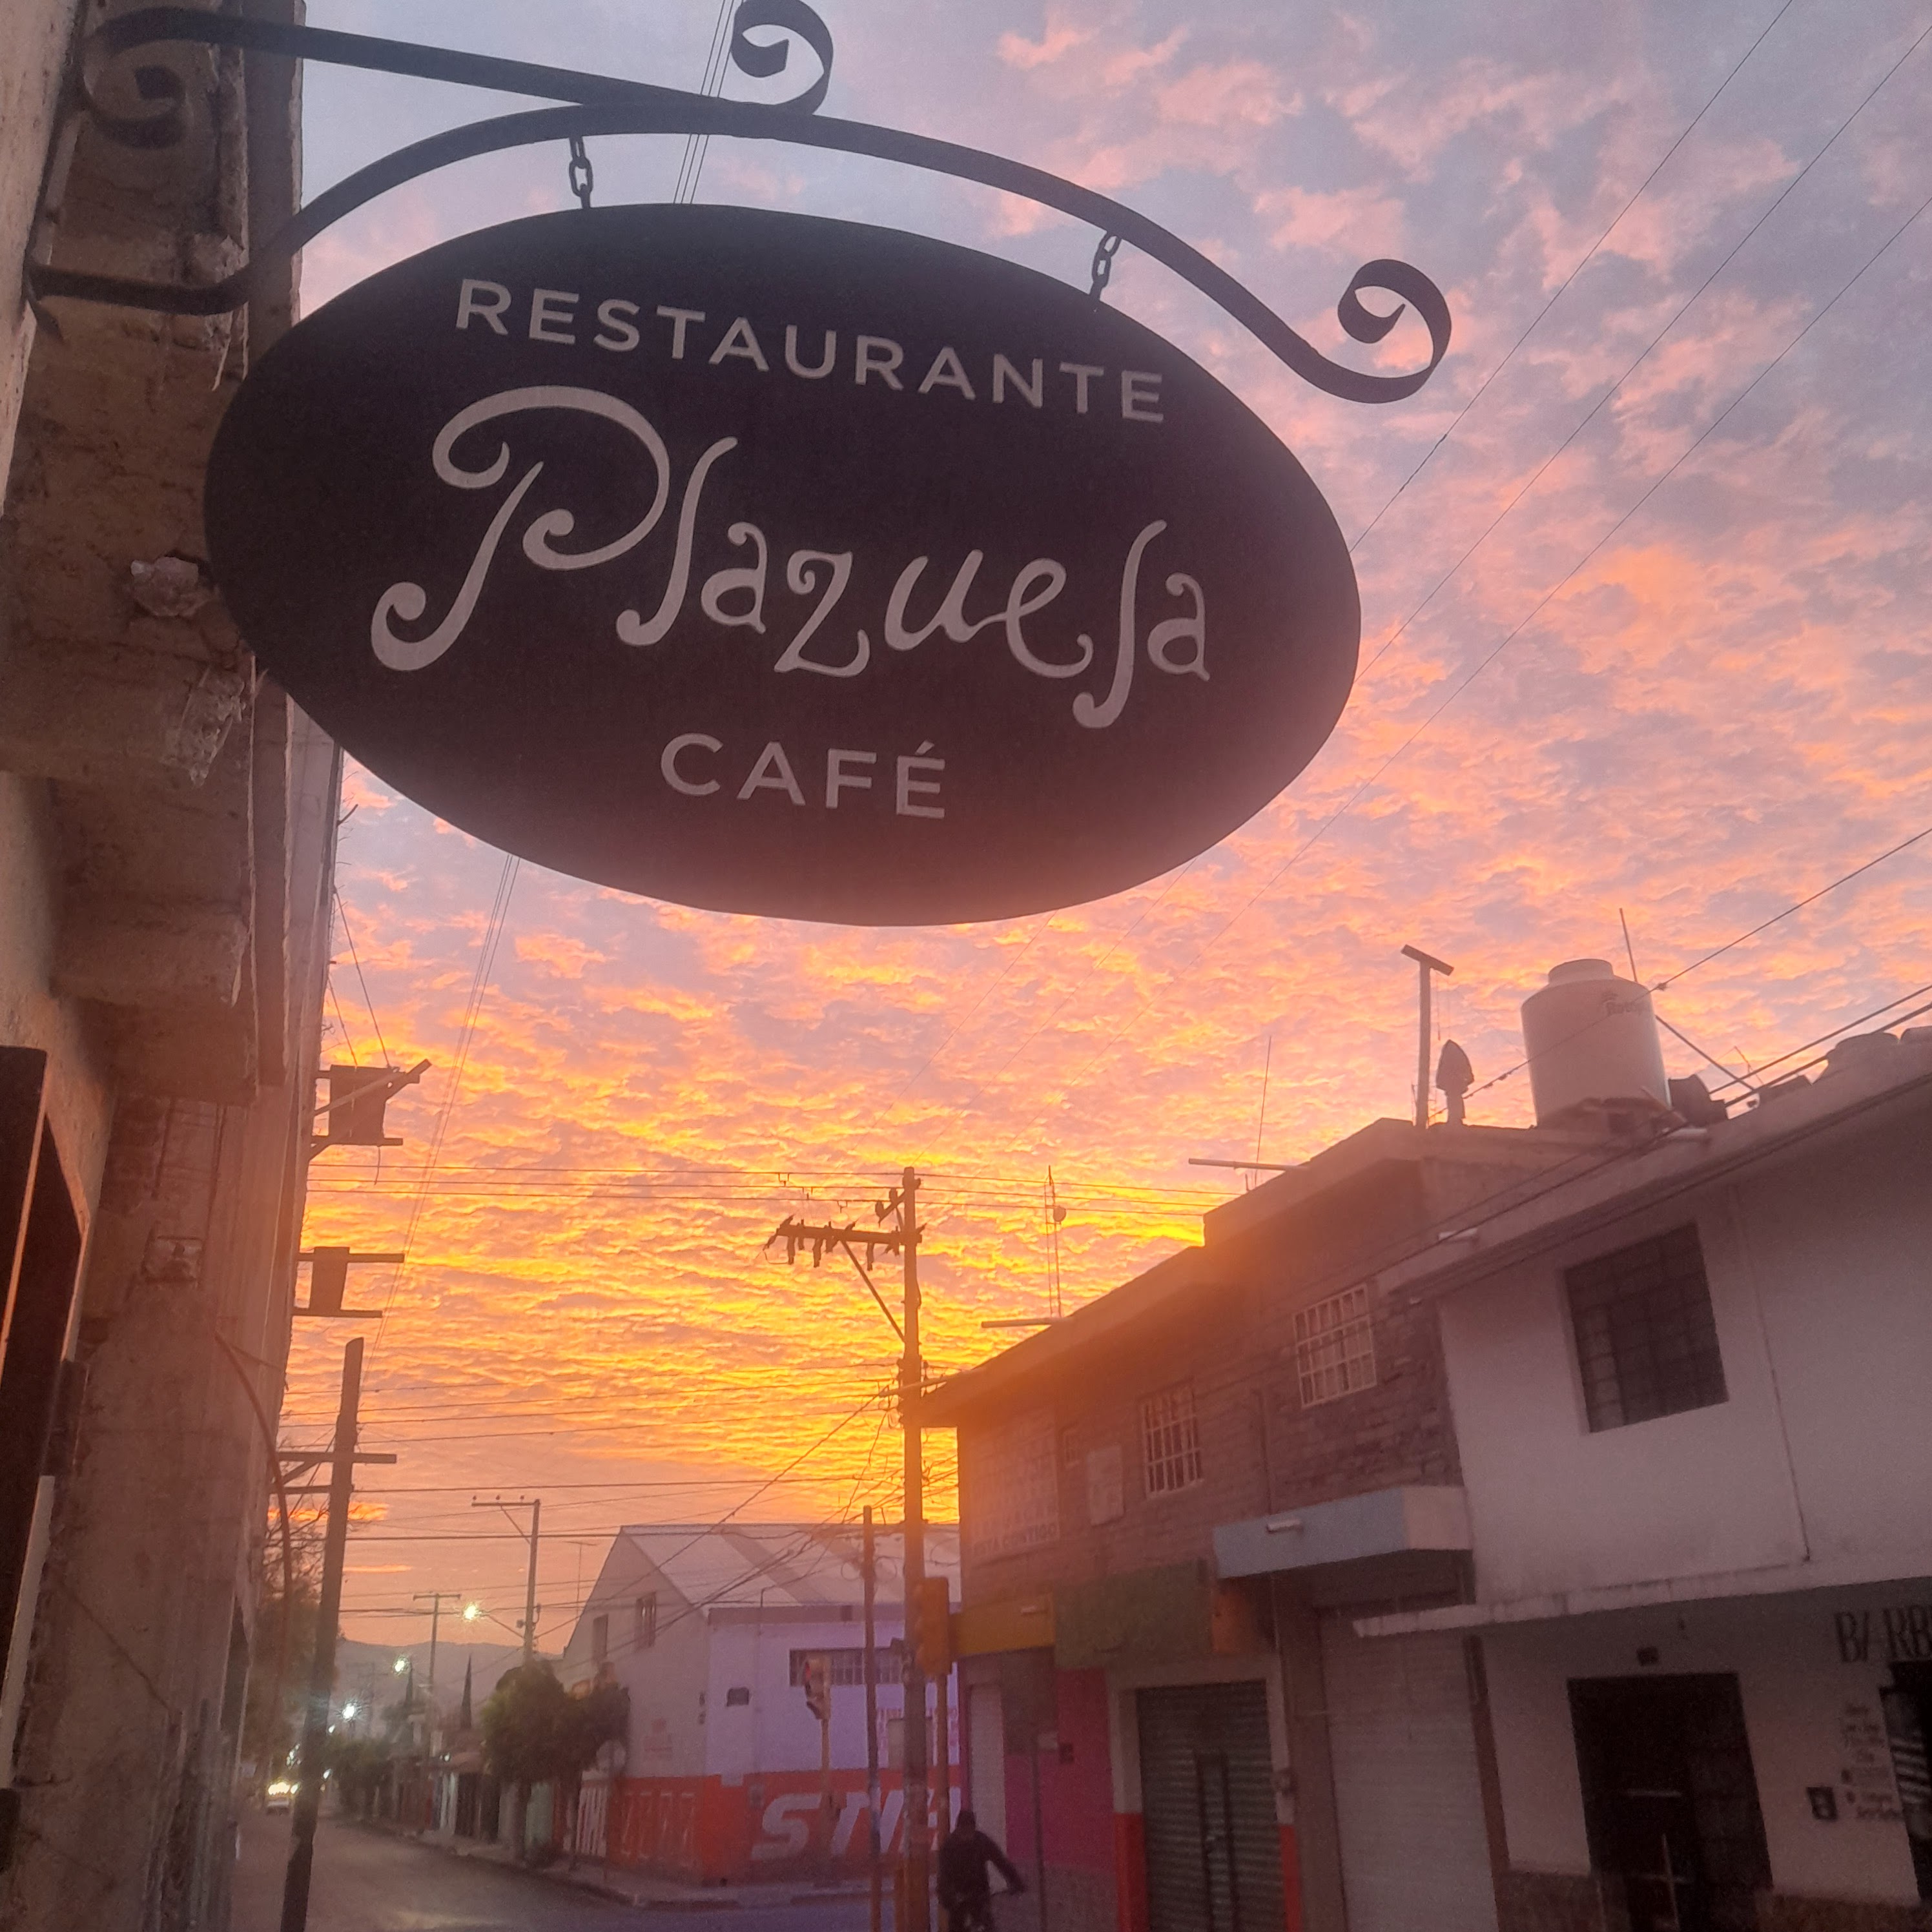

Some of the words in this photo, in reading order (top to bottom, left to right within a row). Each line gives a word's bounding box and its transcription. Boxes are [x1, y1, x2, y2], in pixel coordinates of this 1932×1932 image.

[456, 278, 1164, 424] RESTAURANTE
[371, 385, 1211, 729] Plazuela
[660, 732, 946, 819] CAFÉ
